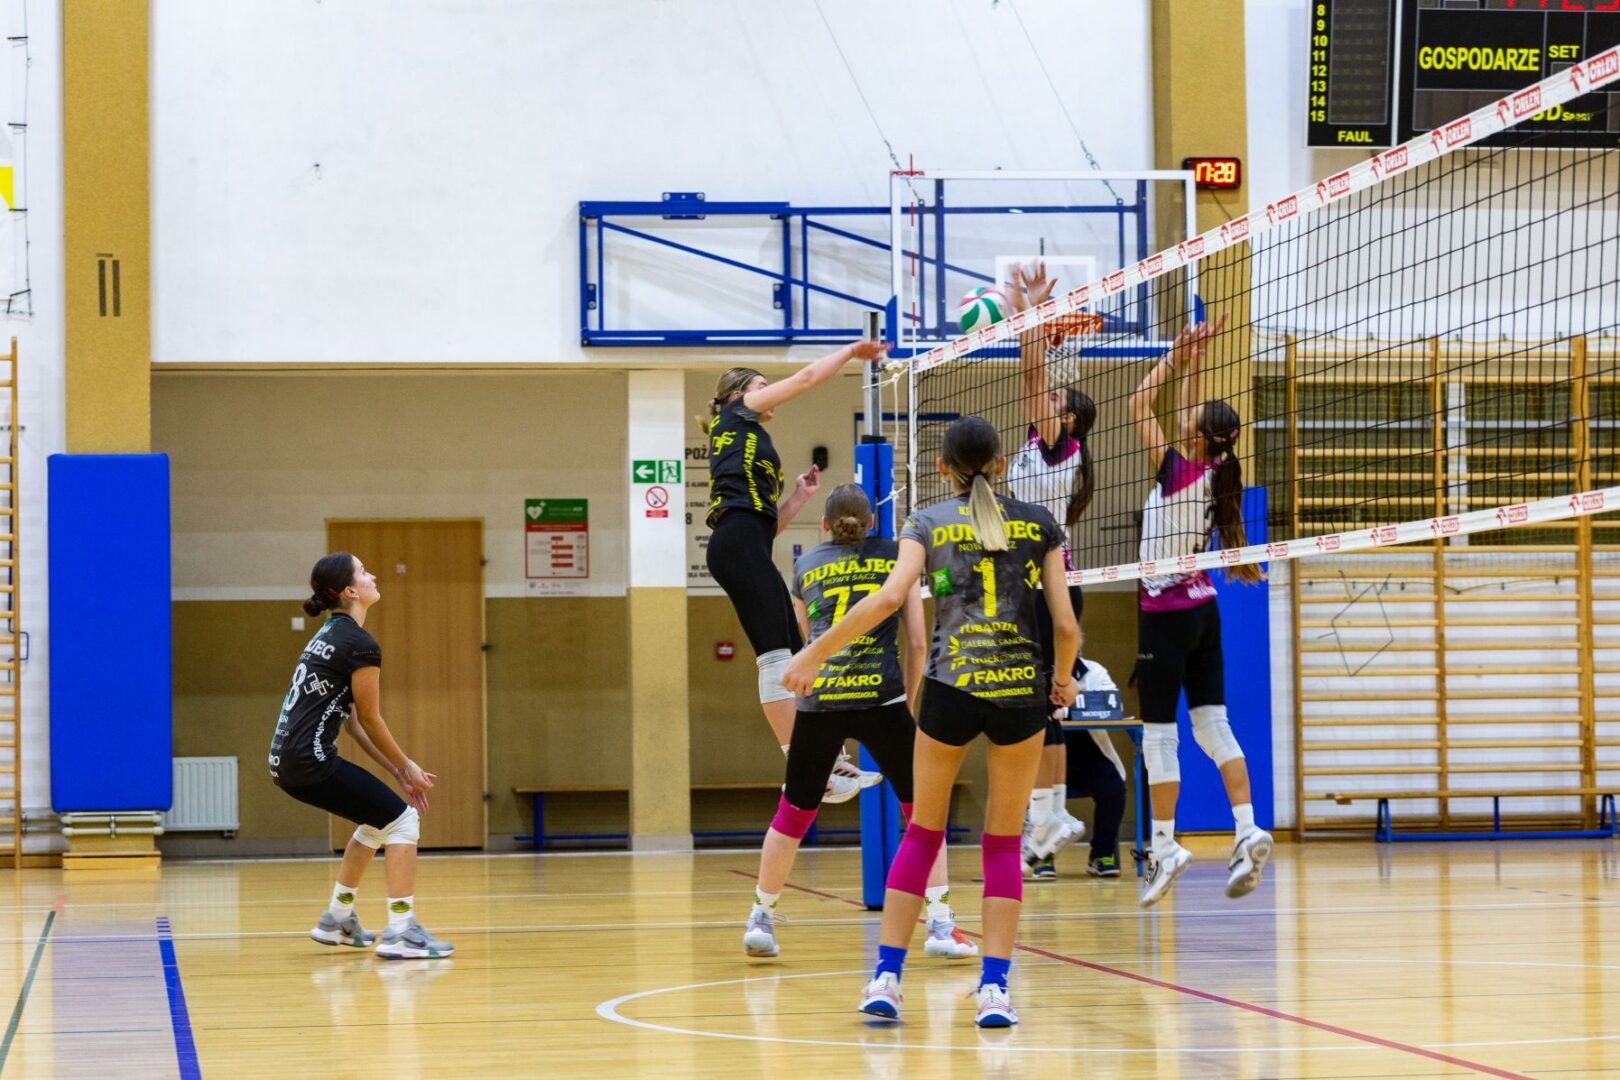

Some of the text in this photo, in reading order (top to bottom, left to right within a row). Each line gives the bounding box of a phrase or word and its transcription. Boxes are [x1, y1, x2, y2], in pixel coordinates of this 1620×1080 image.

[1317, 4, 1326, 16] 8
[1316, 19, 1325, 31] 9
[1313, 35, 1328, 47] 10
[1312, 50, 1326, 62] 11
[1548, 45, 1580, 58] SET
[1419, 47, 1540, 71] GOSPODARZE
[1312, 65, 1327, 77] 12
[1589, 52, 1618, 82] ORLEN
[1312, 80, 1327, 92] 13
[1311, 95, 1326, 107] 14
[1514, 88, 1540, 116] ORLEN
[1310, 110, 1325, 122] 15
[1338, 131, 1373, 142] FAUL
[1196, 162, 1236, 183] 17:28
[973, 557, 997, 618] 1
[826, 674, 883, 688] FAKRO
[973, 666, 1036, 684] FAKRO
[284, 663, 307, 711] 8
[1108, 694, 1117, 709] 4
